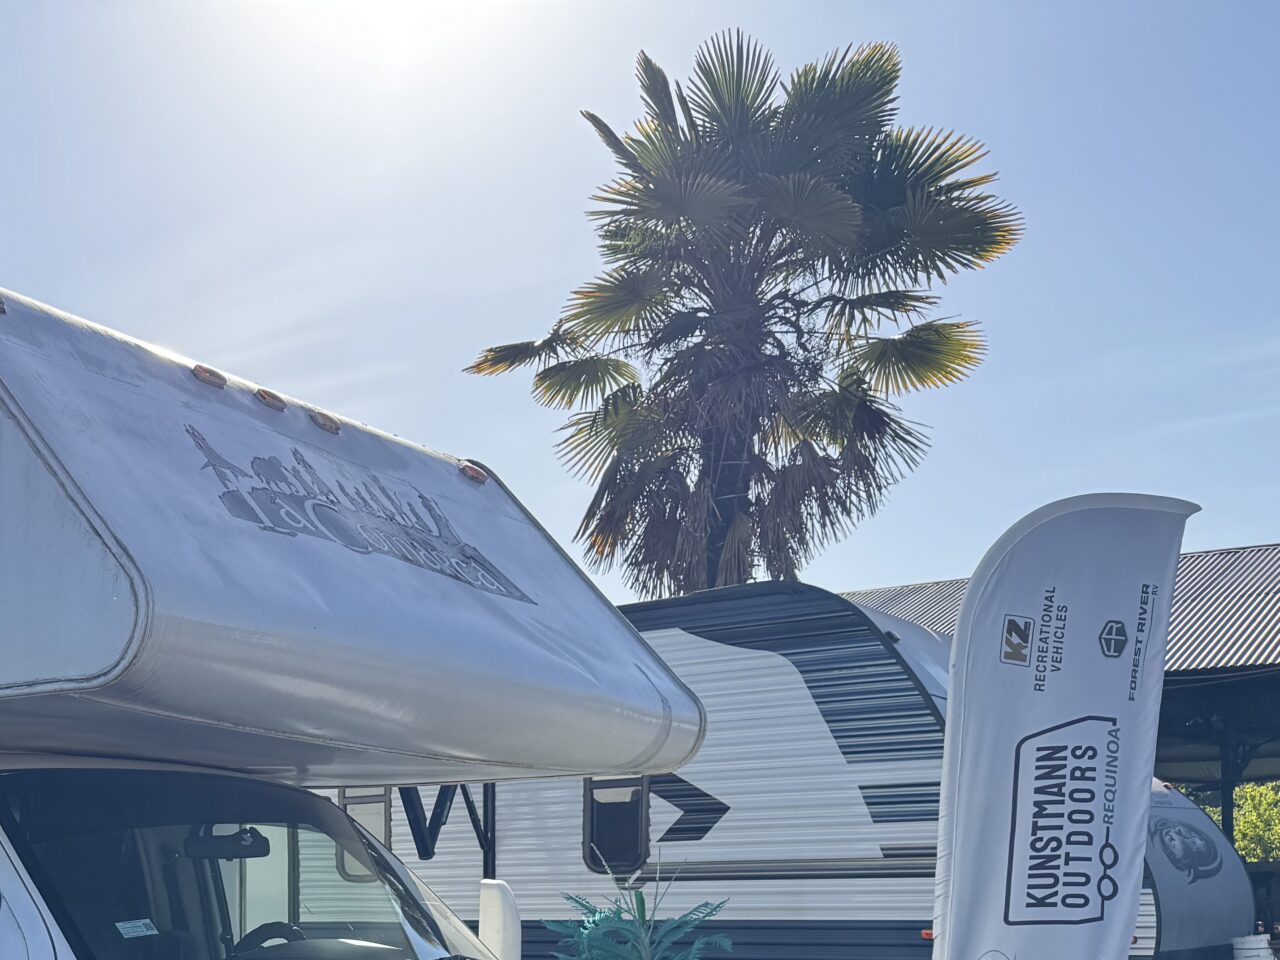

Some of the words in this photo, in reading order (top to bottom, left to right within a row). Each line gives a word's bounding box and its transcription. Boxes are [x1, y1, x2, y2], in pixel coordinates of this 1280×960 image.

[1003, 618, 1032, 663] KZ
[1033, 586, 1056, 692] RECREATIONAL
[1050, 604, 1068, 673] VEHICLES
[1151, 584, 1159, 596] RV
[1128, 636, 1144, 701] FOREST
[1136, 583, 1151, 633] RIVER
[1025, 745, 1068, 908] KUNSTMANN
[1060, 745, 1098, 908] OUTDOORS
[1103, 728, 1121, 825] REQUINOA
